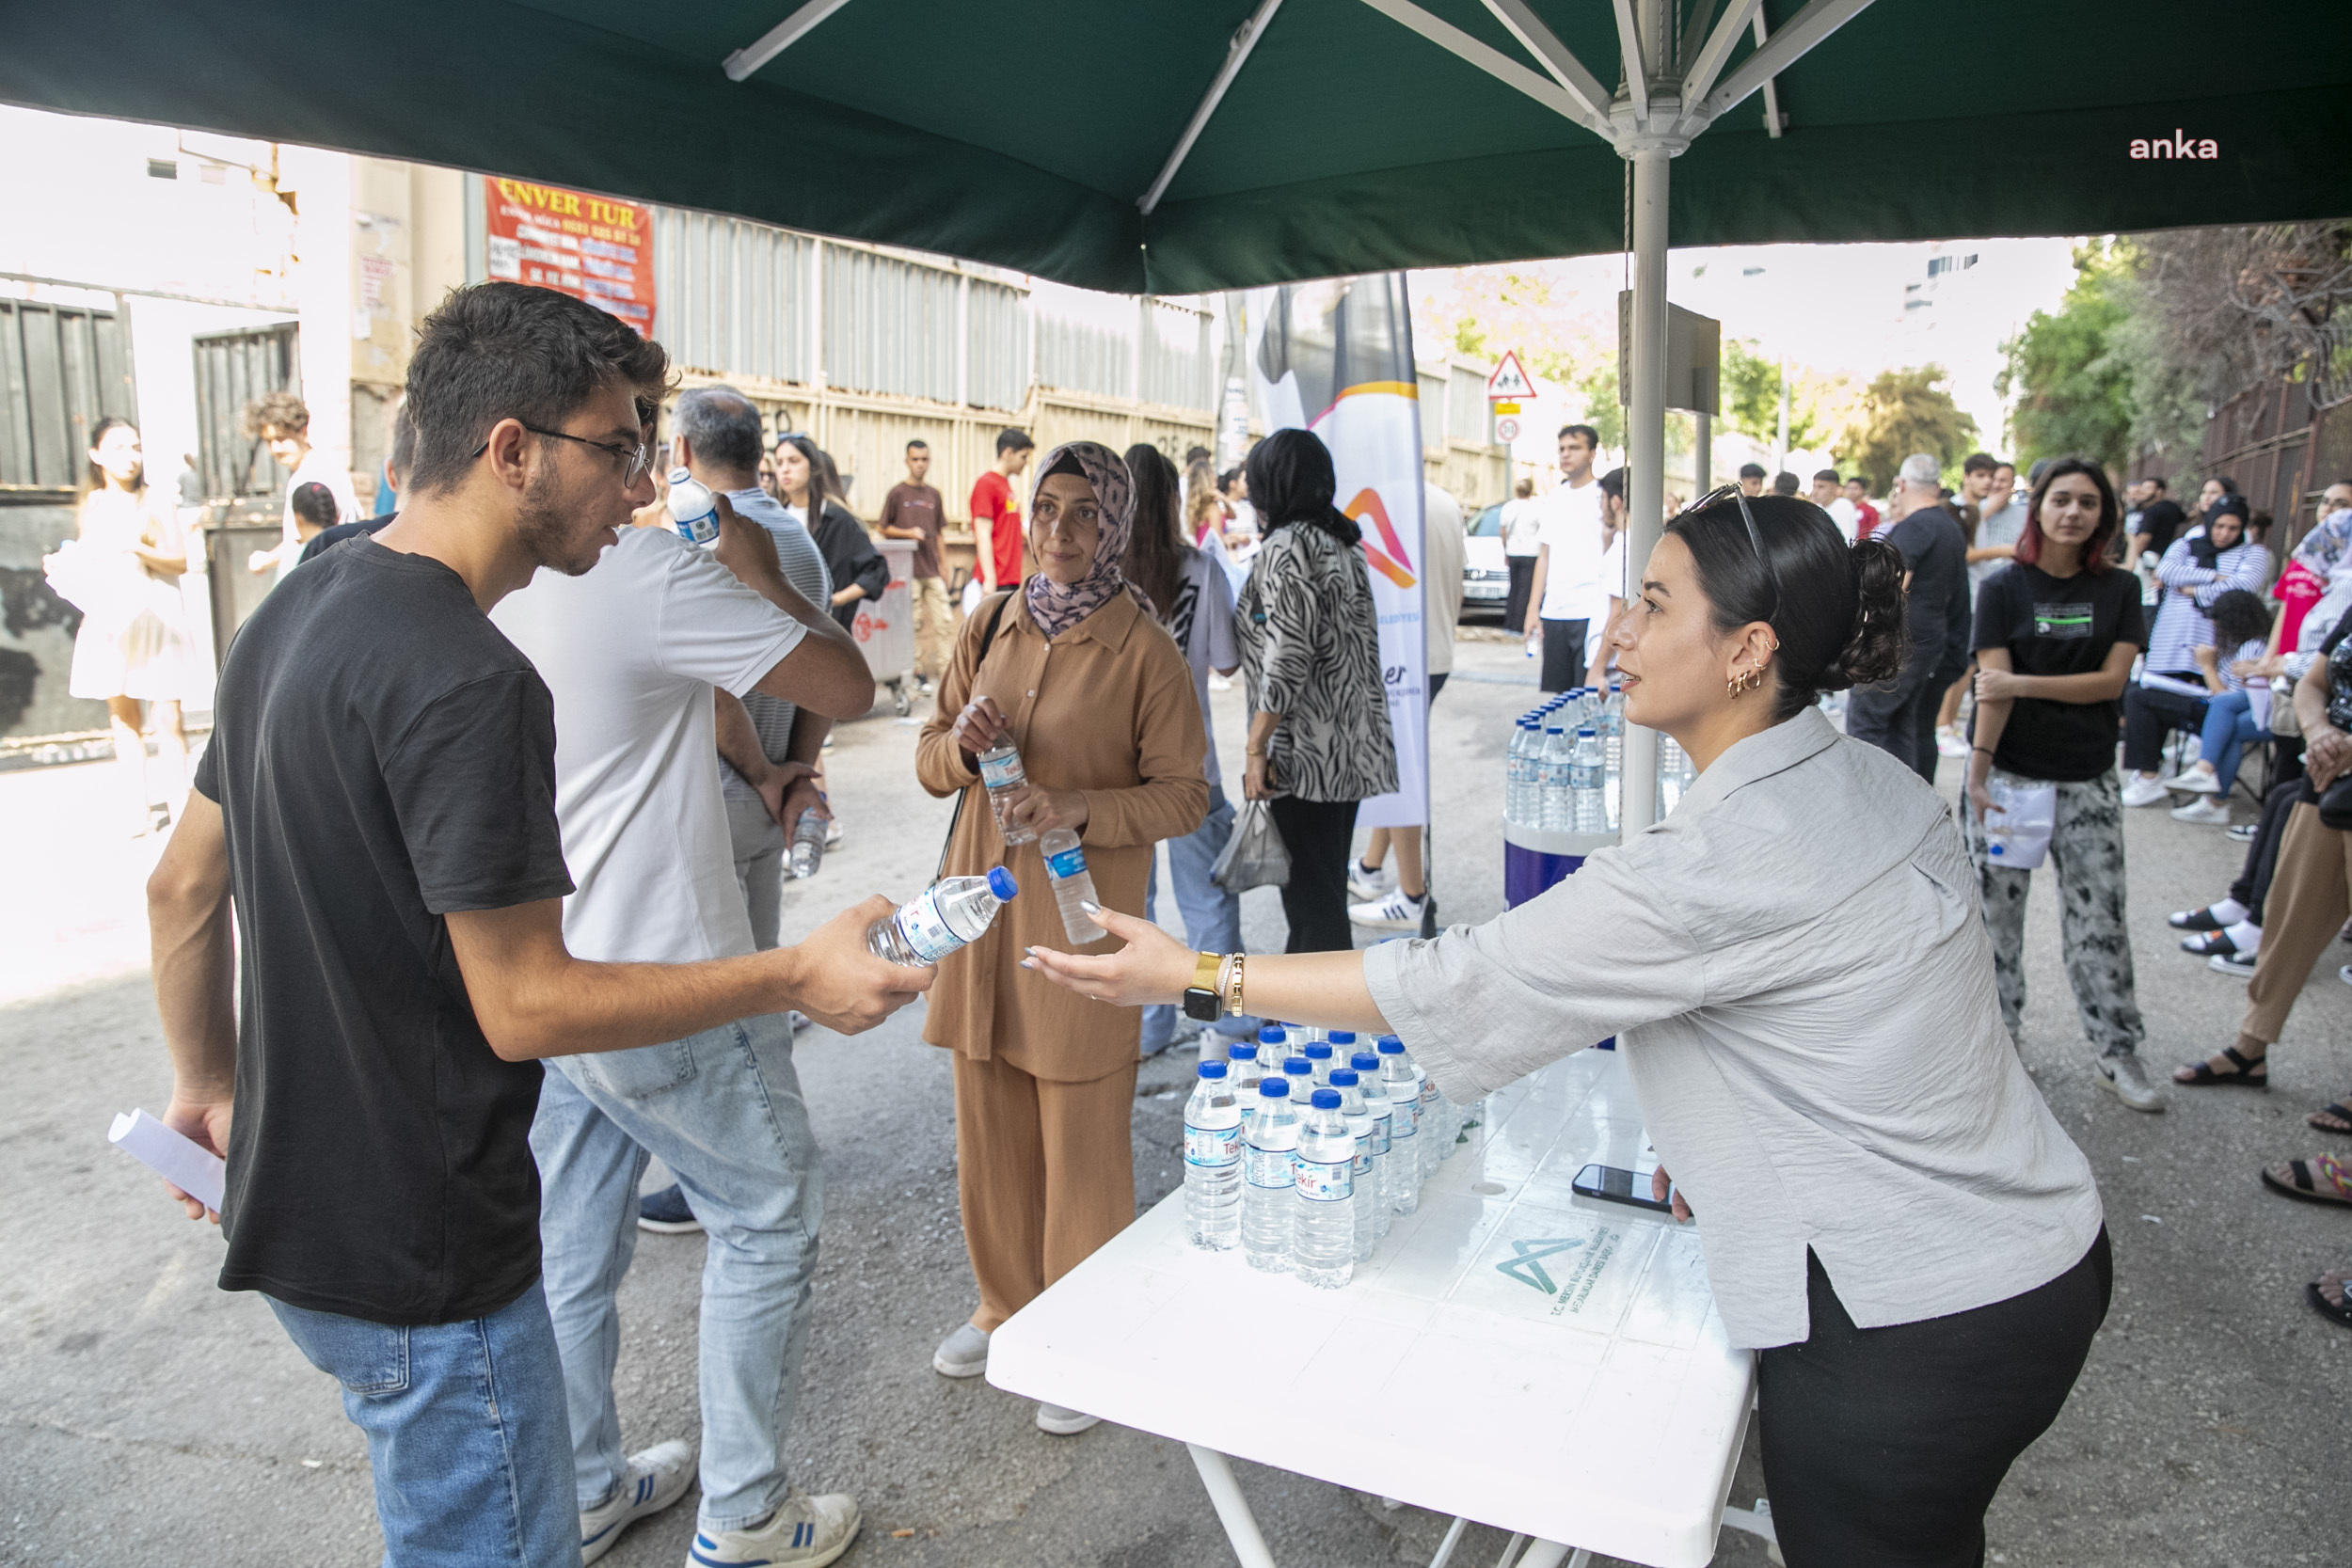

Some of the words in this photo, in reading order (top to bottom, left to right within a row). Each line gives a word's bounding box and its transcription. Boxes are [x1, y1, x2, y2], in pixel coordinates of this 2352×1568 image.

[499, 178, 580, 217] ENVER
[586, 198, 636, 230] TUR
[1384, 665, 1407, 685] er
